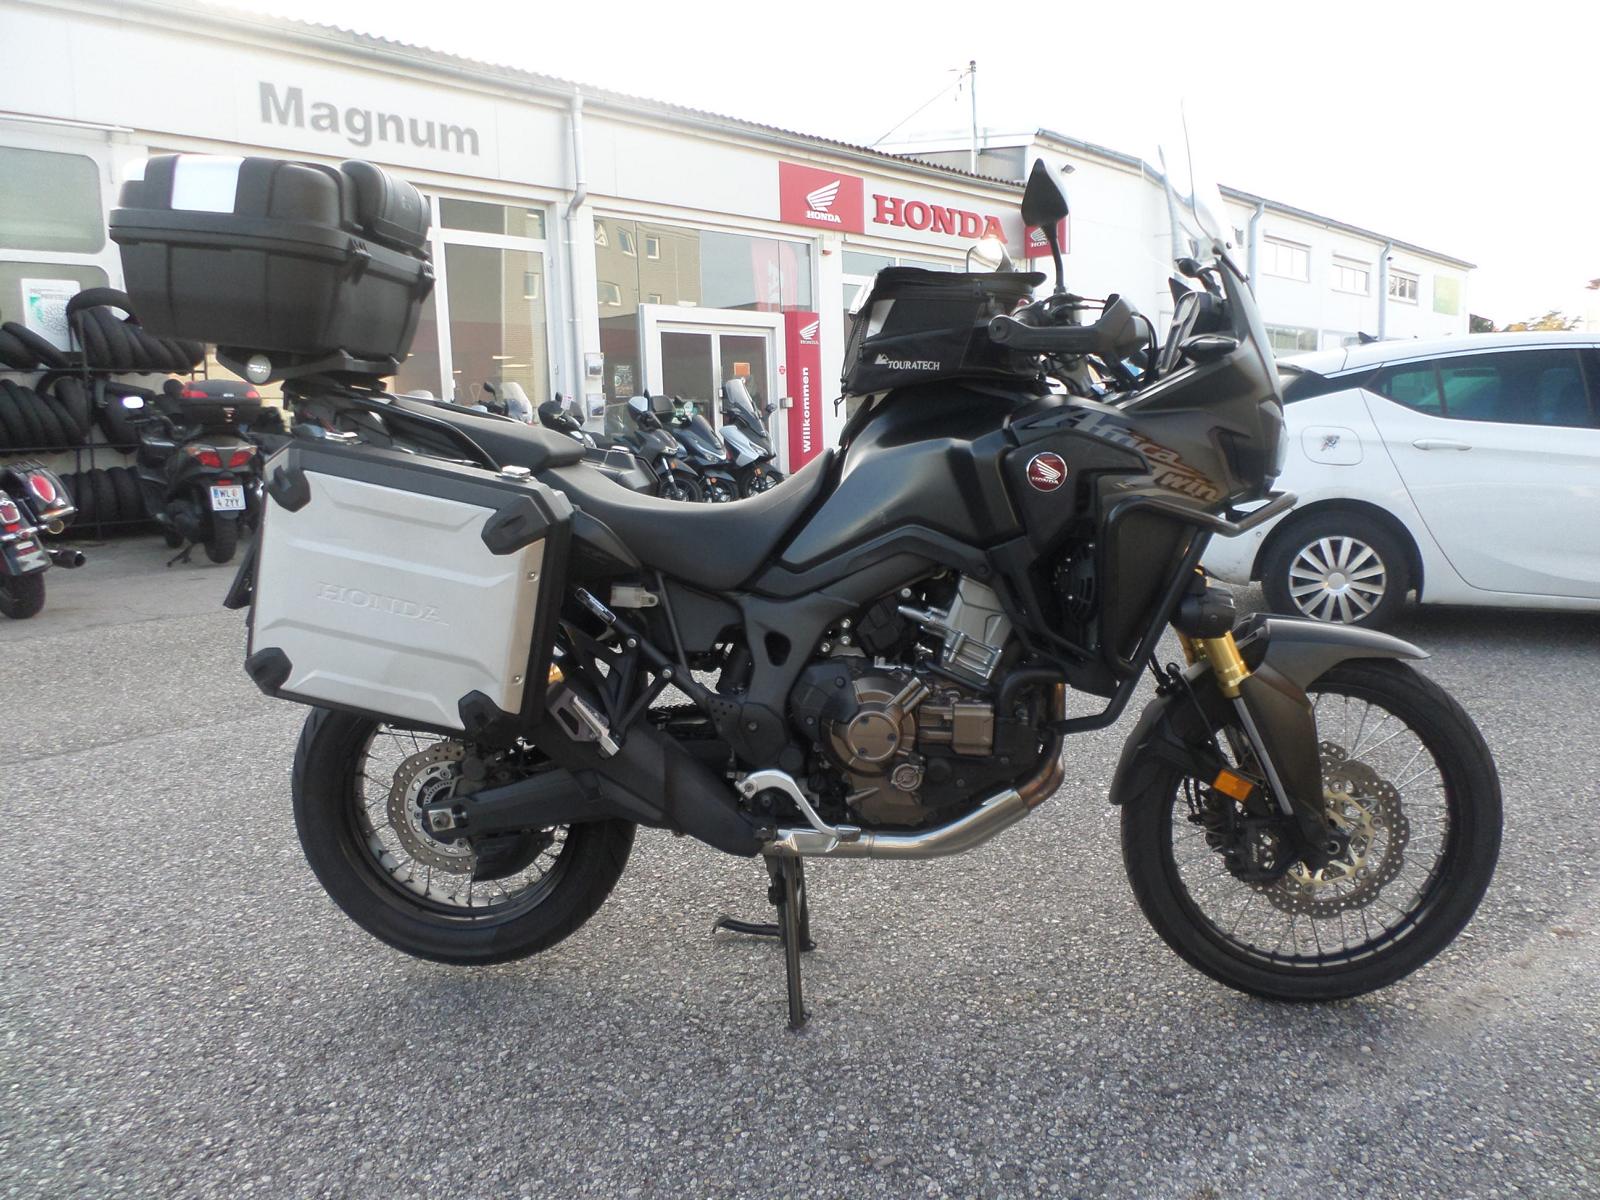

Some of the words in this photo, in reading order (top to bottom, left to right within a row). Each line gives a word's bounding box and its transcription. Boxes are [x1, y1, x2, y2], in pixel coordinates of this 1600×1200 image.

[258, 81, 480, 156] Magnum
[806, 210, 842, 223] HONDA
[872, 193, 1009, 244] HONDA
[888, 360, 941, 371] TOURATECH
[802, 367, 811, 453] Willkommen
[1031, 476, 1060, 485] HONDA
[1149, 458, 1218, 501] Twin
[316, 580, 450, 627] HONDA
